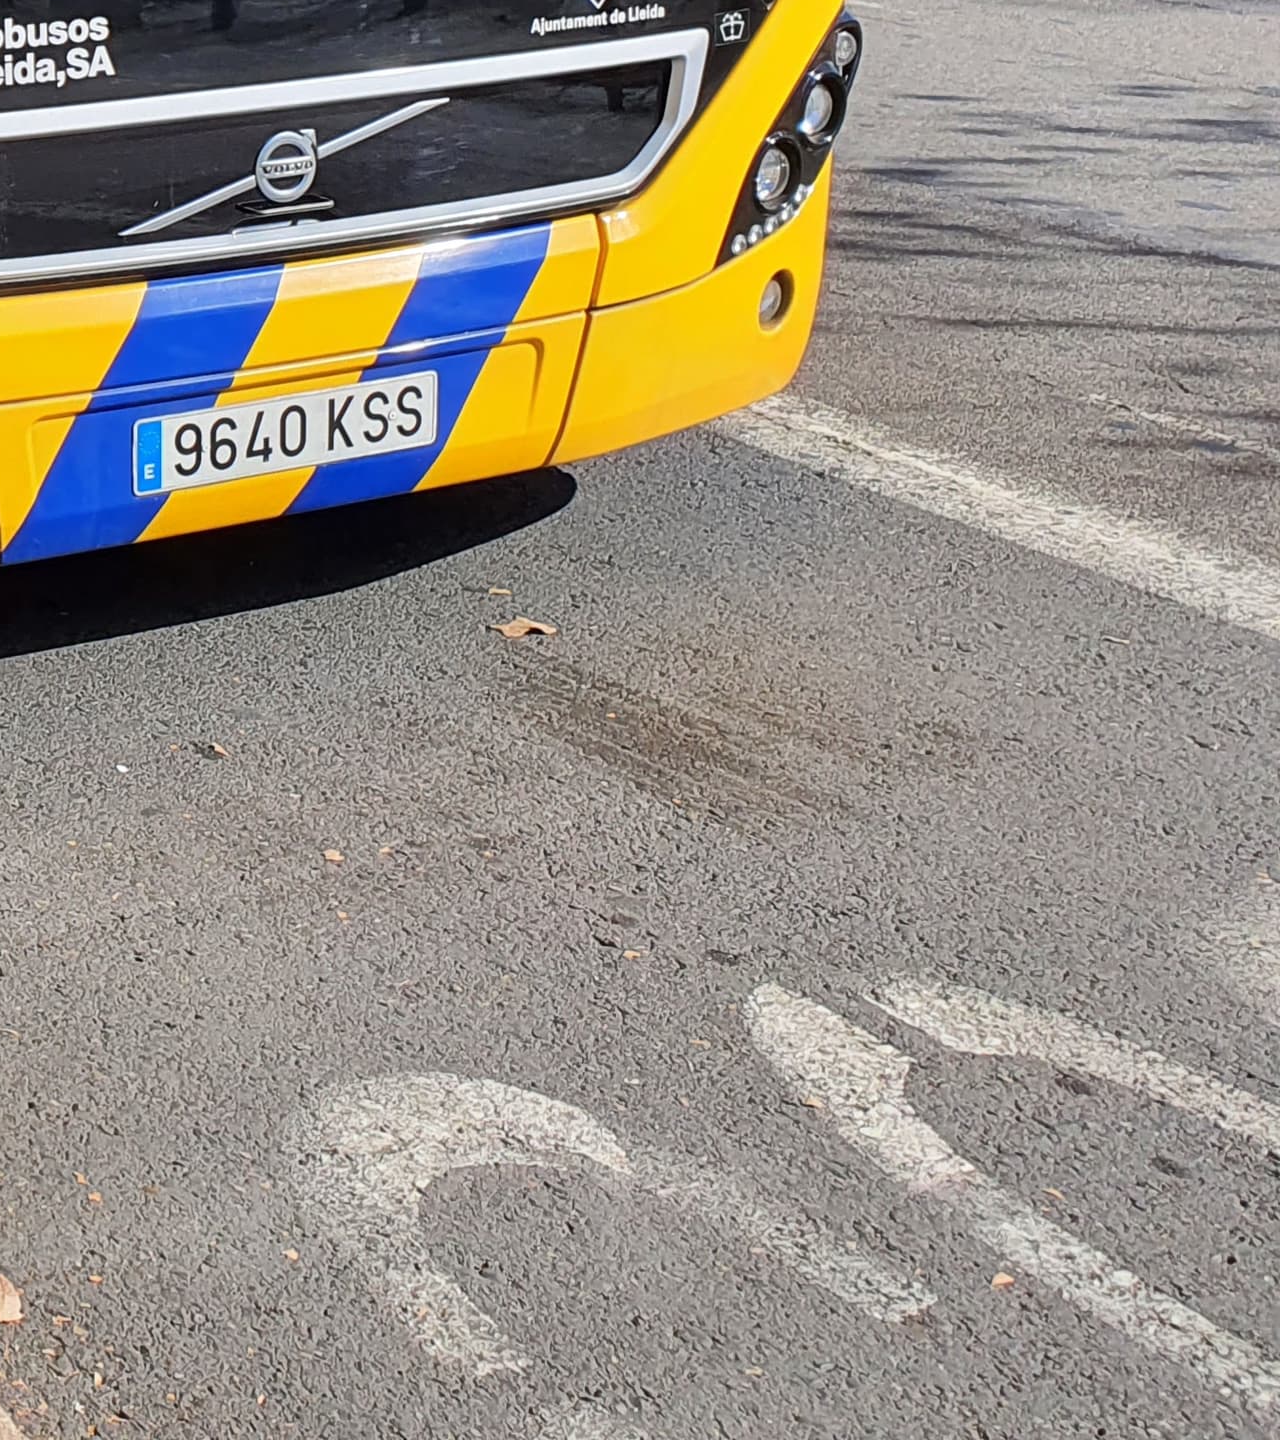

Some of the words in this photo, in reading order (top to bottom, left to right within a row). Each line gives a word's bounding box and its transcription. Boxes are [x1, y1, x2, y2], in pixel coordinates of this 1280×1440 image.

[530, 10, 608, 36] Ajuntament
[609, 8, 626, 24] de
[628, 3, 665, 21] Lleida
[262, 160, 314, 175] VOLVO
[174, 404, 307, 476] 9640
[328, 386, 423, 451] KSS
[143, 463, 156, 480] E
